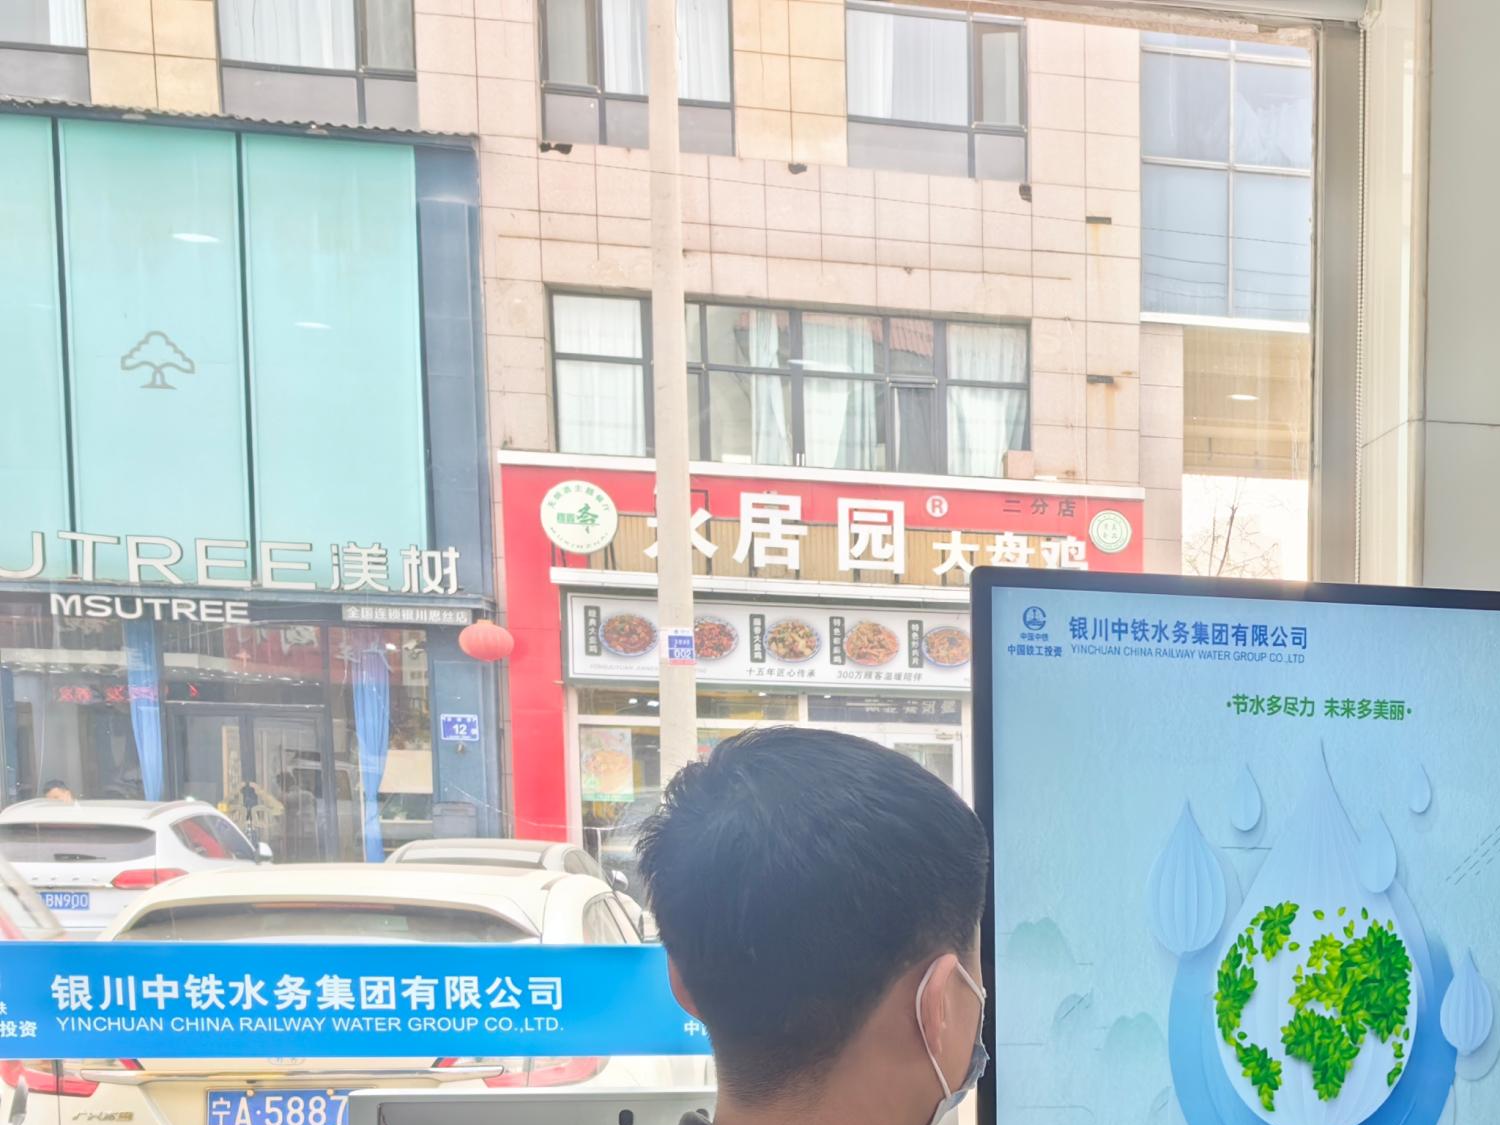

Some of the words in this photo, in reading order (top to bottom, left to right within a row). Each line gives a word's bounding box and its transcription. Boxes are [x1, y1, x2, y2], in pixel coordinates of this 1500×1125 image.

[932, 531, 1088, 576] 大盘鸡
[51, 594, 250, 624] MSUTREE
[1069, 616, 1308, 650] 银川中铁水务集团有限公司
[1007, 644, 1062, 657] 中国铁工投资
[1071, 643, 1121, 656] YINCHUAN
[1123, 646, 1153, 657] CHINA
[1154, 648, 1196, 660] RAILWAY
[1198, 650, 1231, 661] WATER
[1232, 652, 1267, 663] GROUP
[453, 724, 467, 735] 12
[51, 973, 563, 1011] 银川中铁水务集团有限公司
[56, 1016, 164, 1032] YINCHUAN
[170, 1016, 234, 1032] CHINA
[238, 1016, 328, 1032] RAILWAY
[331, 1016, 402, 1032] WATER
[407, 1016, 480, 1032] GROUP
[484, 1016, 564, 1035] CO.,LTD.
